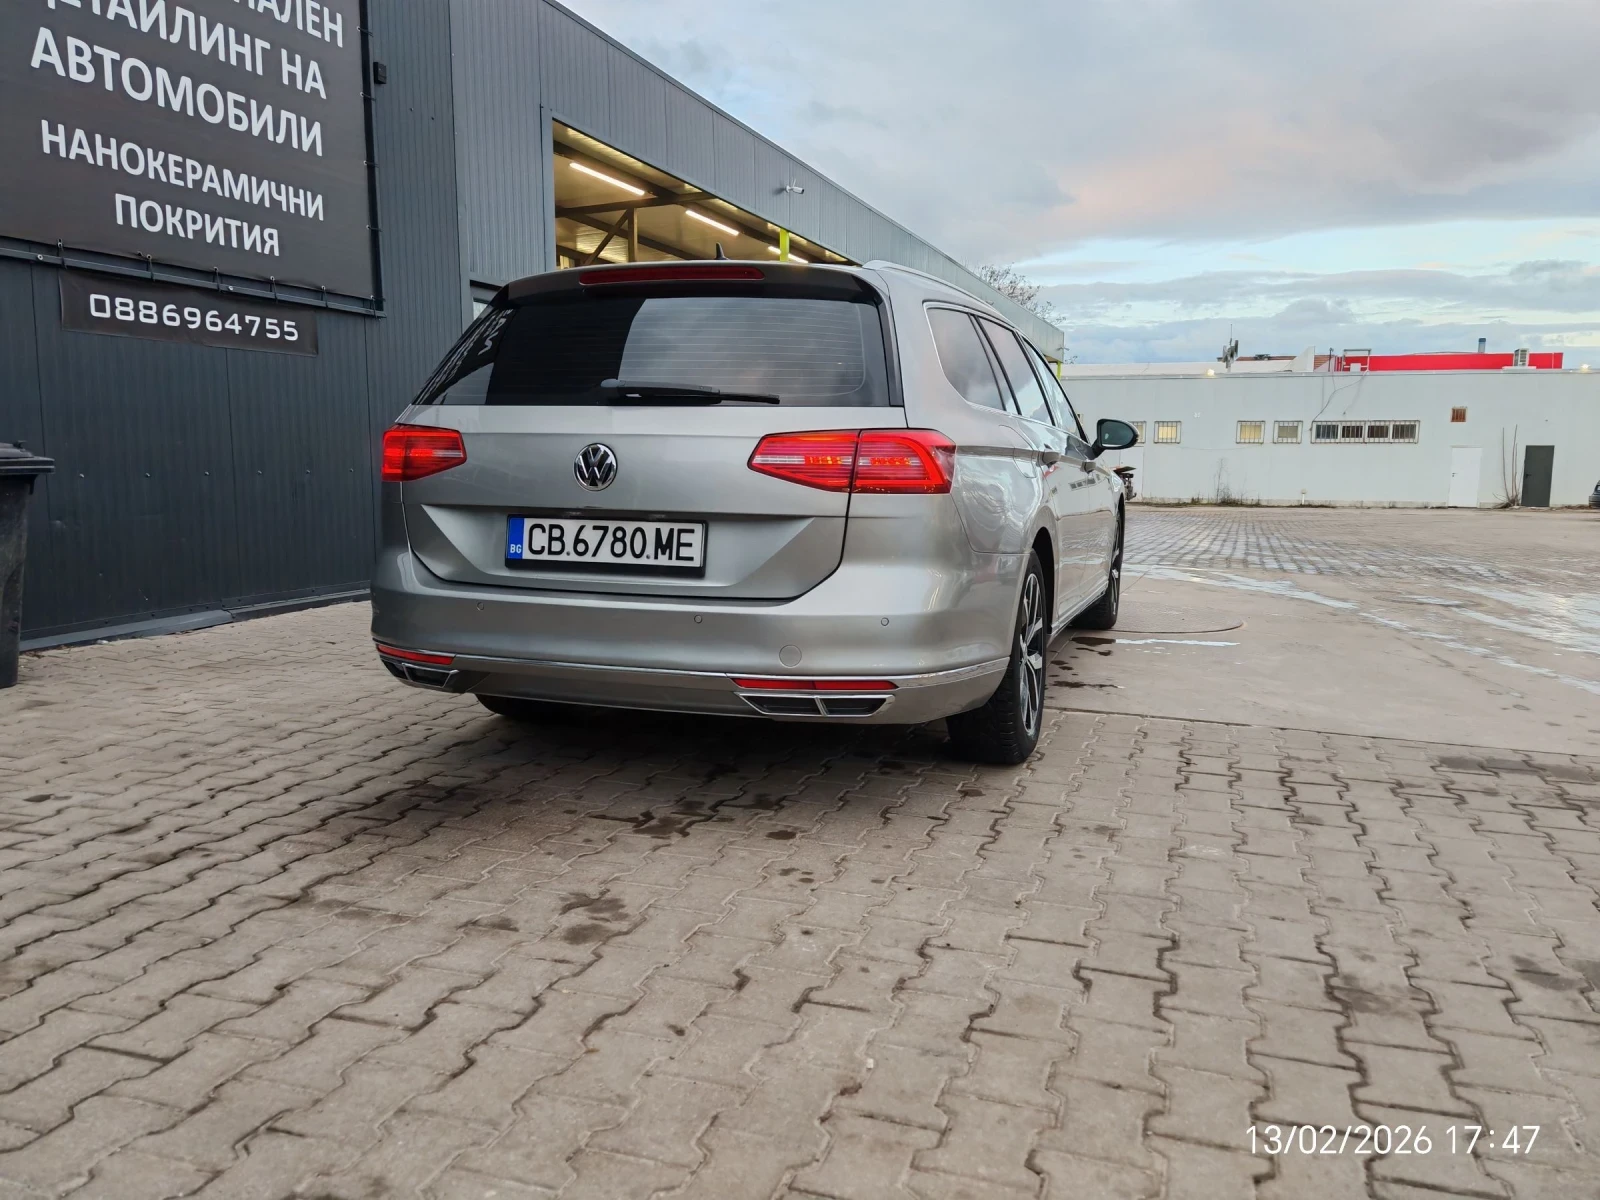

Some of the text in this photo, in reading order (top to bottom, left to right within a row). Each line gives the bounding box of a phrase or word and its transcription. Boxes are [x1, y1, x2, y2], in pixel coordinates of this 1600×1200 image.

[31, 26, 323, 157] АВТОМОБИЛИ
[280, 48, 327, 100] НА
[41, 119, 324, 221] НАНОКЕРАМИЧНИ
[115, 193, 280, 257] ПОКРИТИЯ
[89, 293, 299, 341] 0886964755
[510, 544, 522, 554] BG
